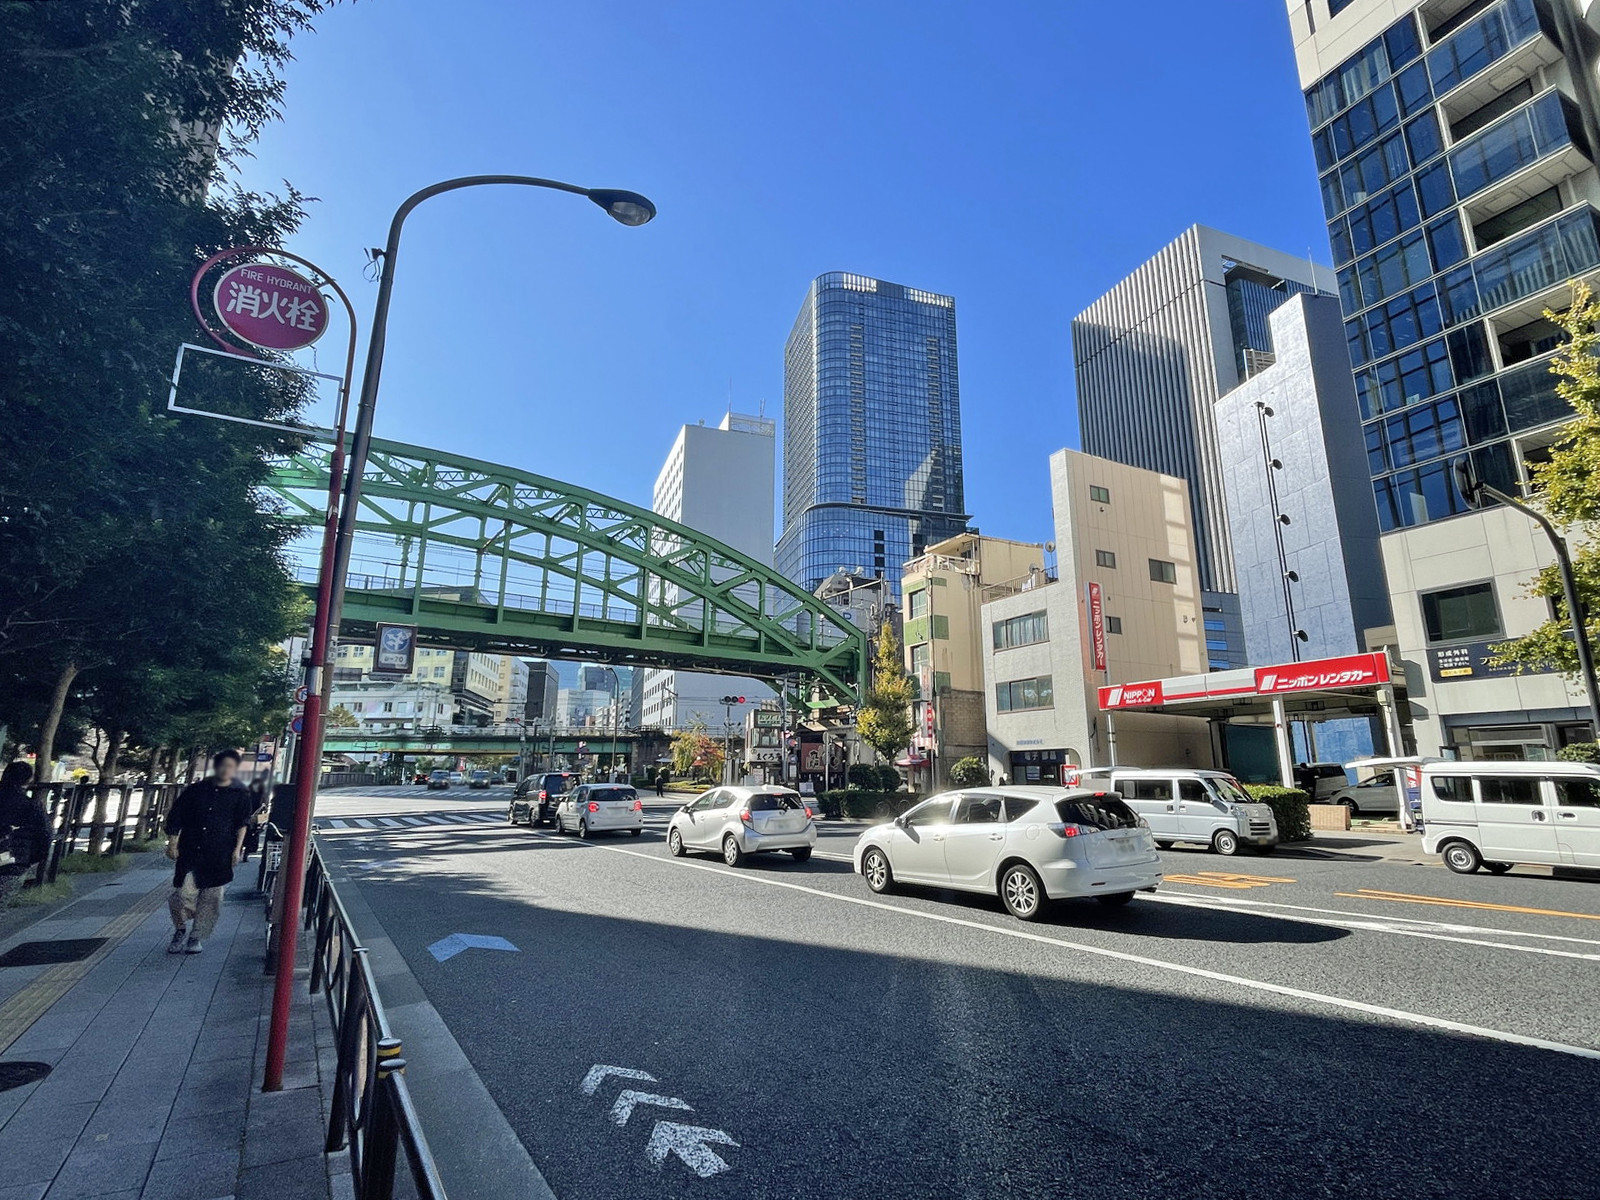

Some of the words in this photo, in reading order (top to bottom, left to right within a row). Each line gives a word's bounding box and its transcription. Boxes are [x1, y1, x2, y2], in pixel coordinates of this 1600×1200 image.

[241, 269, 264, 282] FIRE
[266, 275, 313, 294] HYDRANT
[226, 281, 320, 332] 消火栓
[1123, 688, 1155, 700] NIPPON
